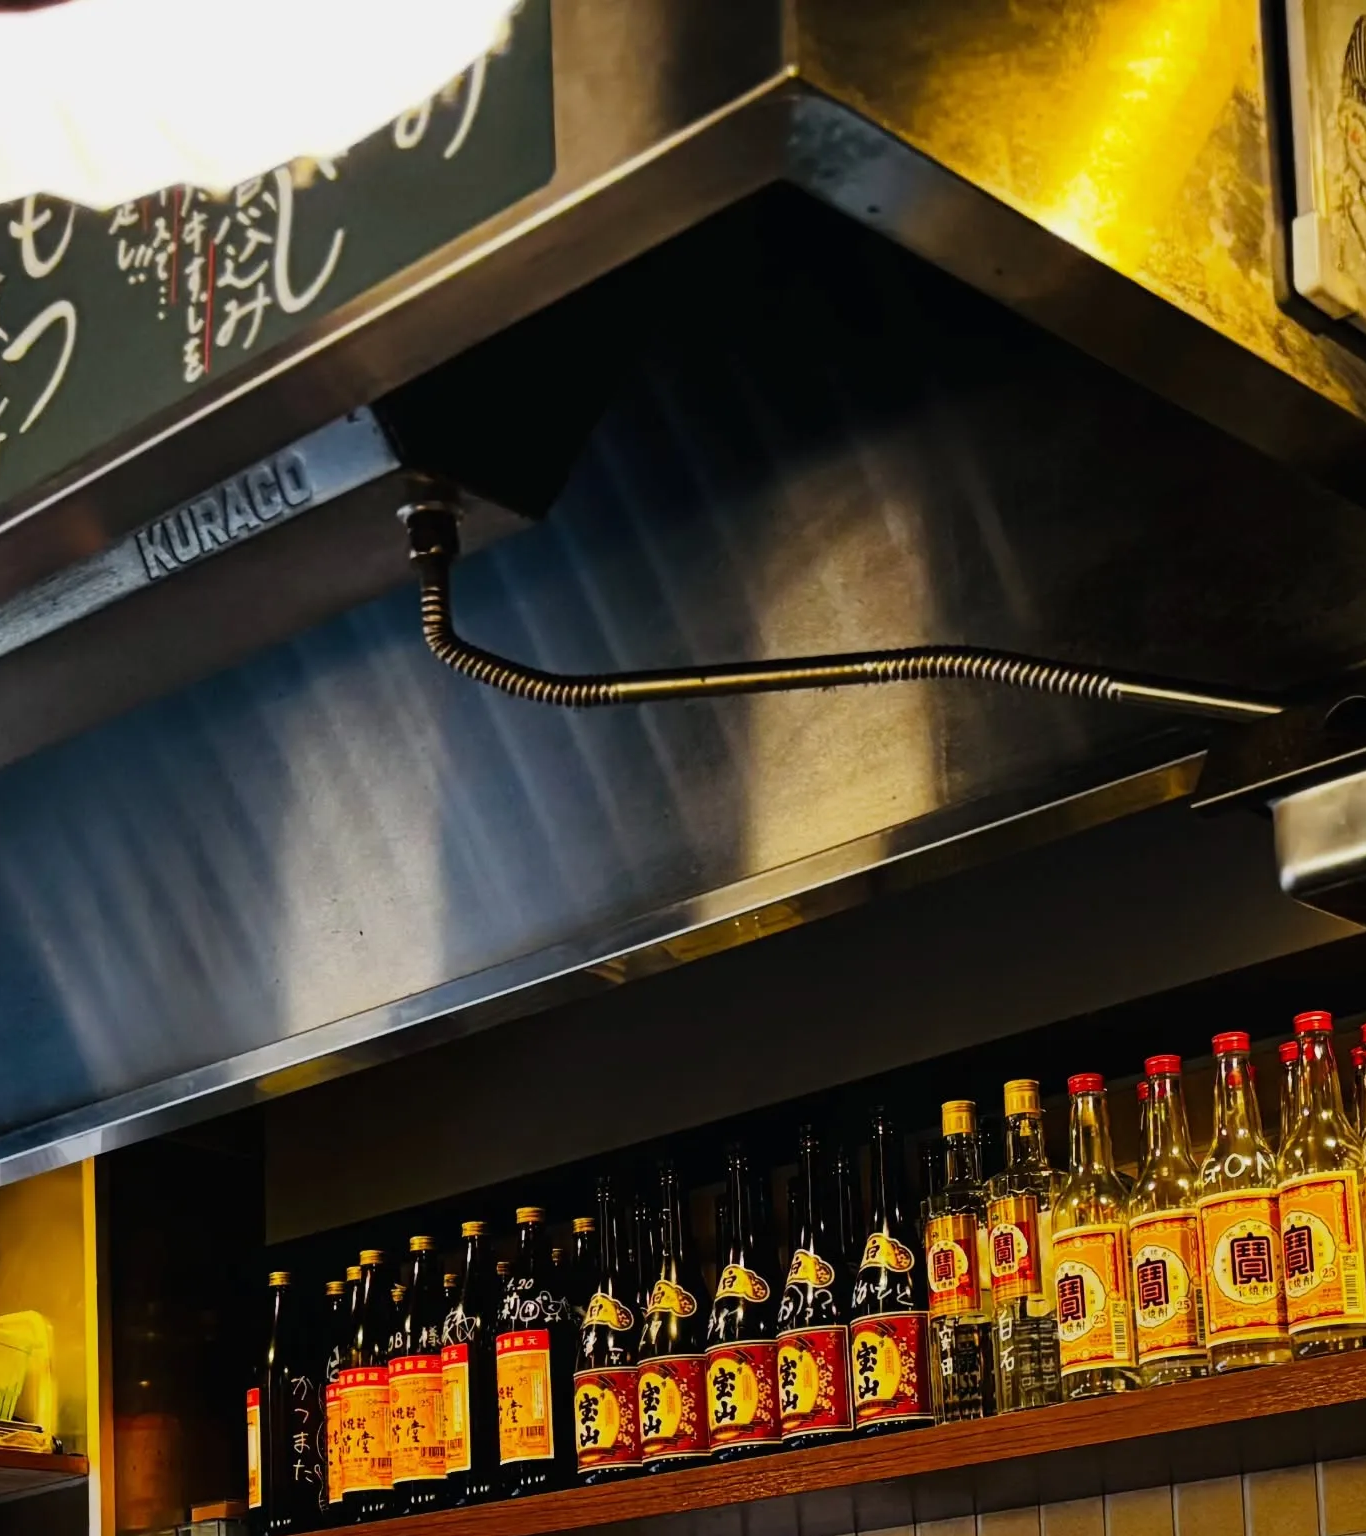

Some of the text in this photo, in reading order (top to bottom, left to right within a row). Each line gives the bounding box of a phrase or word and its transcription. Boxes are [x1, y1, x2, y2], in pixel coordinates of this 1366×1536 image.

[137, 448, 316, 581] KURACO
[1230, 1231, 1274, 1286] 寶
[1283, 1223, 1315, 1282] 寶
[1321, 1268, 1337, 1280] 25
[1057, 1272, 1087, 1326] 寶
[1136, 1256, 1170, 1311] 寶
[1176, 1299, 1191, 1312] 25
[998, 1310, 1016, 1371] 白石
[1092, 1313, 1107, 1326] 25
[712, 1367, 738, 1424] 宝山
[779, 1355, 799, 1413] 宝山
[854, 1340, 881, 1400] 宝山
[290, 1374, 315, 1484] かつまた
[578, 1392, 600, 1447] 宝山
[640, 1381, 662, 1437] 宝山
